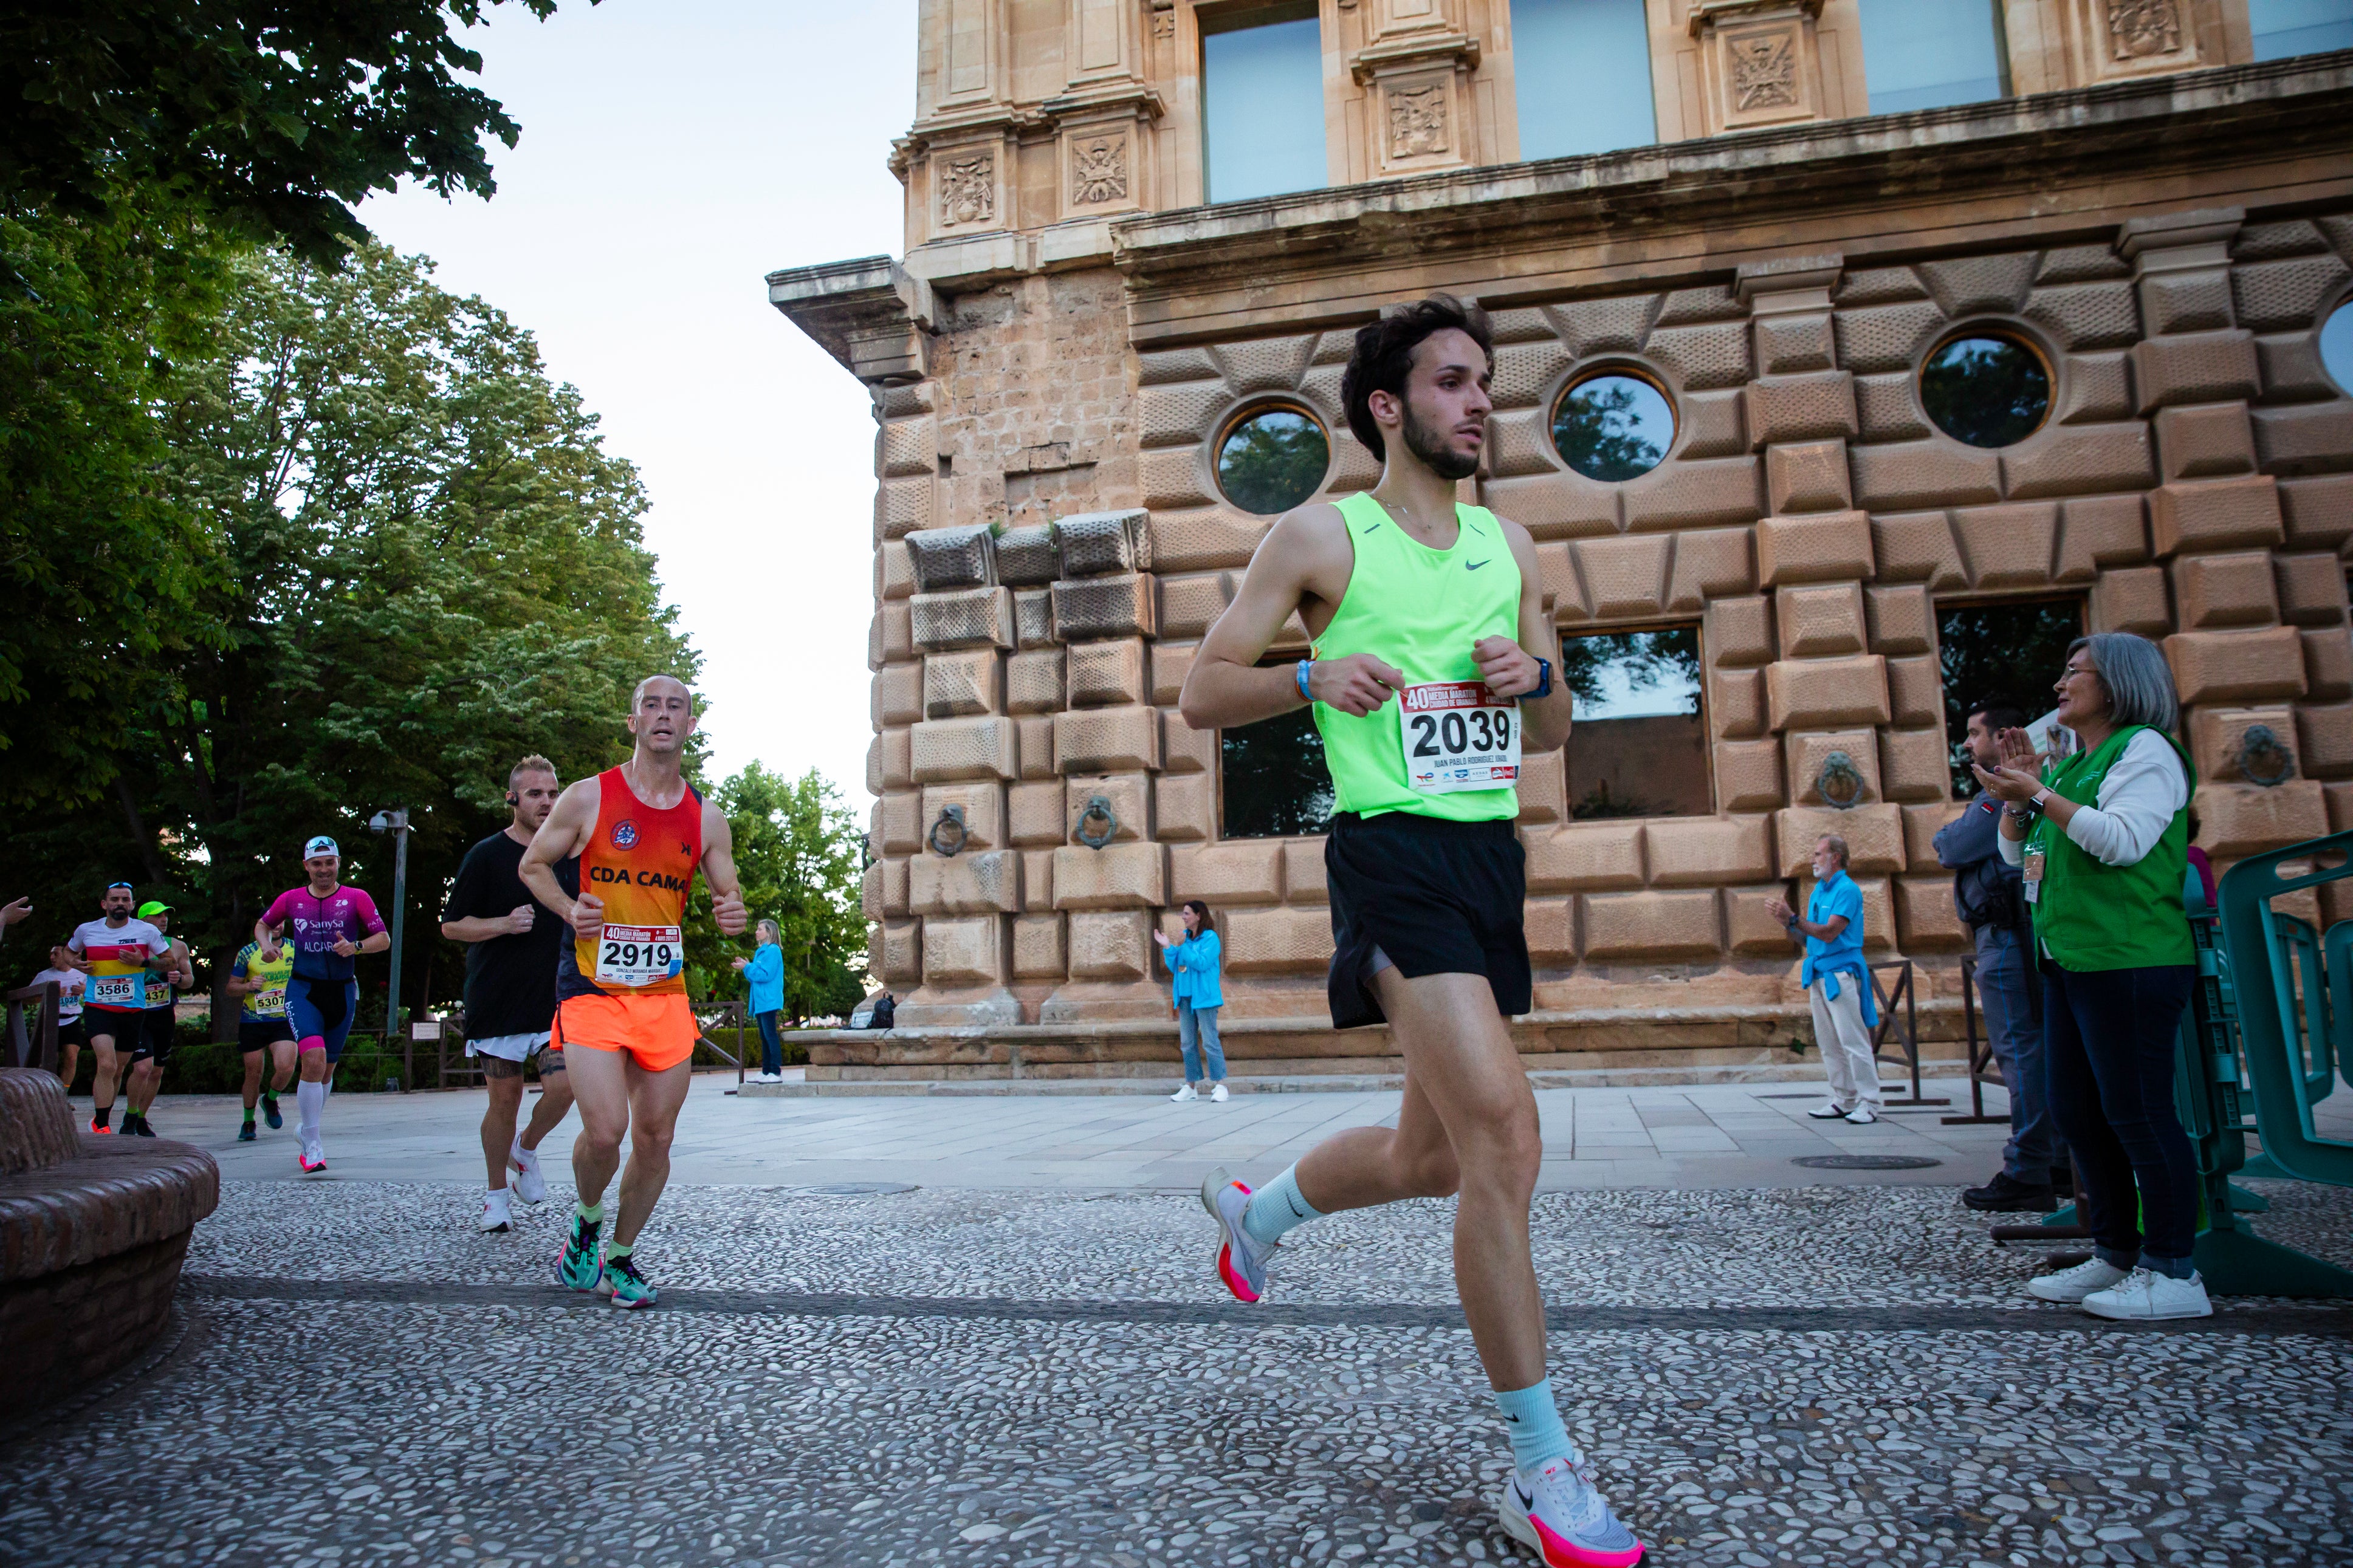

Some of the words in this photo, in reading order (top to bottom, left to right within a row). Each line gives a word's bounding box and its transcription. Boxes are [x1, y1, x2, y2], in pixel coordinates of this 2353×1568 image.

[1407, 688, 1429, 710] 40
[1429, 690, 1449, 700] MEDIA
[1410, 710, 1510, 758] 2039
[1434, 759, 1448, 768] JUAN
[1449, 758, 1467, 766] PABLO
[590, 866, 631, 885] CDA
[309, 919, 344, 930] SanySa
[606, 926, 620, 939] 40
[304, 942, 335, 953] ALCAR
[603, 942, 672, 967] 2919
[97, 984, 130, 996] 3586
[258, 996, 285, 1007] 5307
